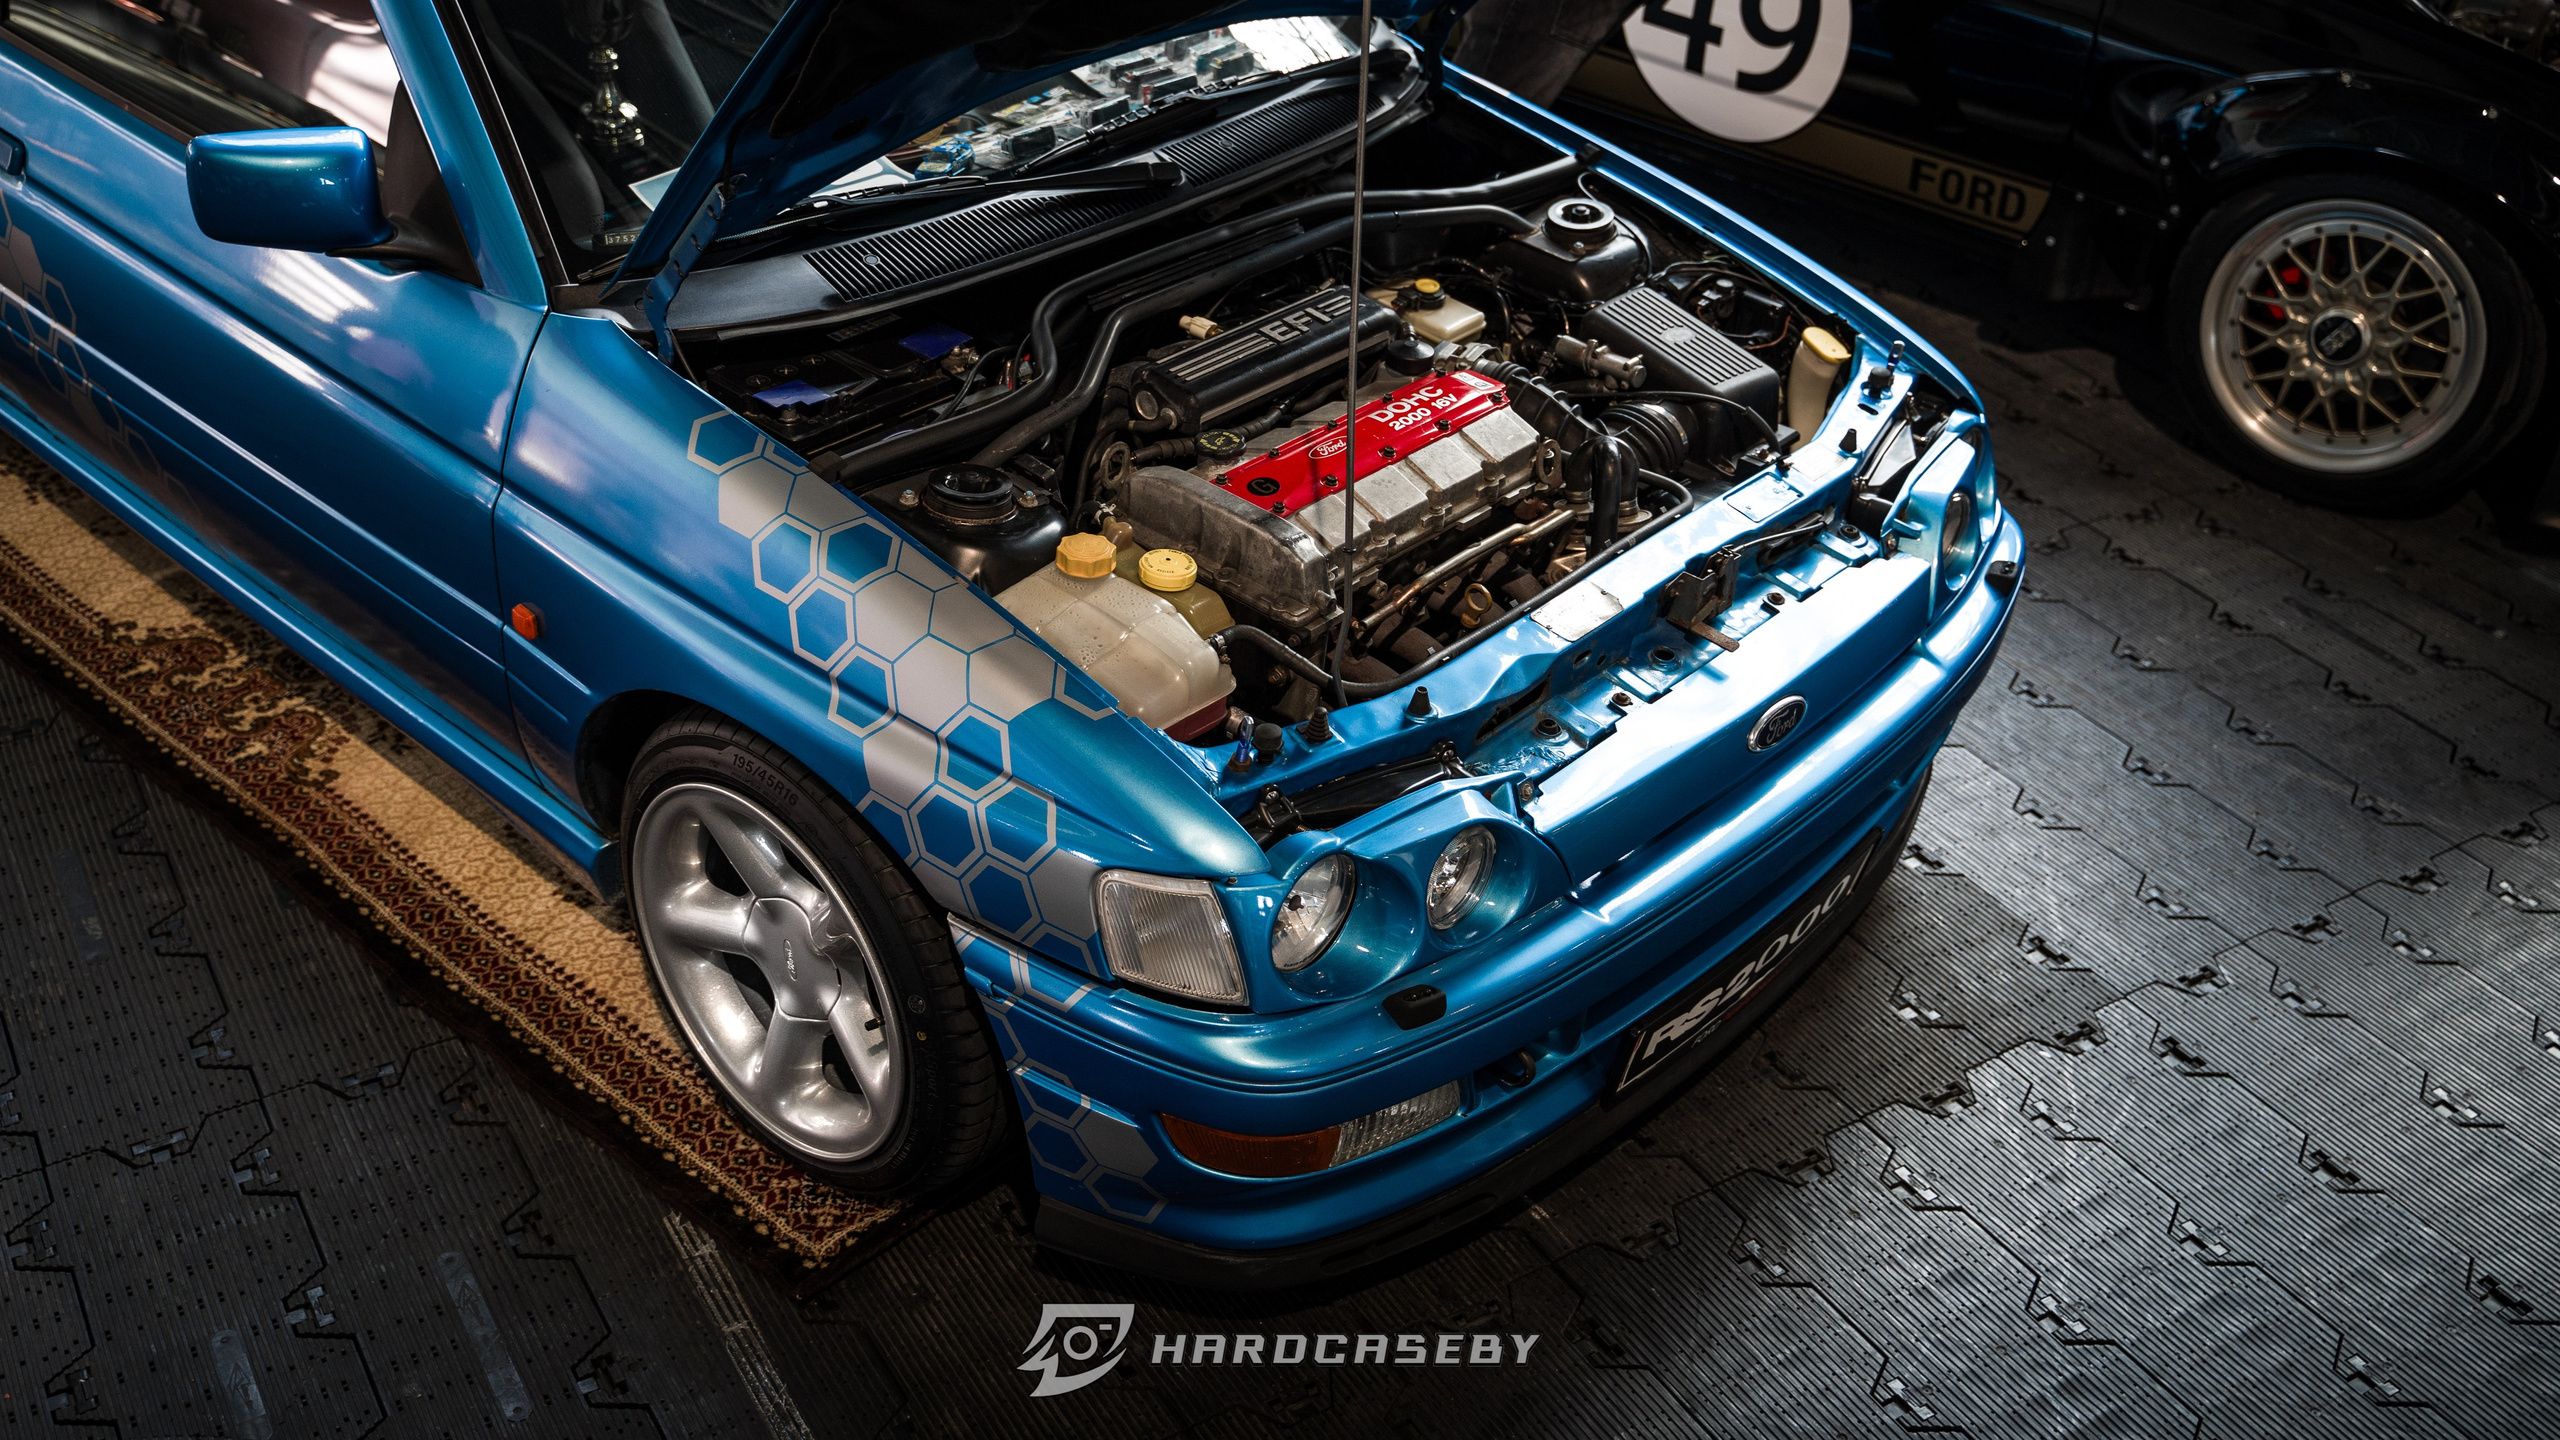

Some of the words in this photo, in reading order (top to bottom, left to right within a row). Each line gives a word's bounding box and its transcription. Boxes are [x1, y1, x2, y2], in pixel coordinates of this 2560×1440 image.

[1642, 0, 1822, 94] 49
[1908, 157, 2028, 223] FORD
[1260, 307, 1333, 342] EFI
[1367, 386, 1444, 423] DOHC
[1388, 407, 1432, 431] 2000
[1431, 393, 1459, 409] 16V
[1316, 439, 1348, 456] Ford
[1251, 479, 1277, 494] G
[1766, 708, 1798, 745] Ford
[731, 753, 800, 807] 195/45R16
[1641, 874, 1851, 1061] RS2000
